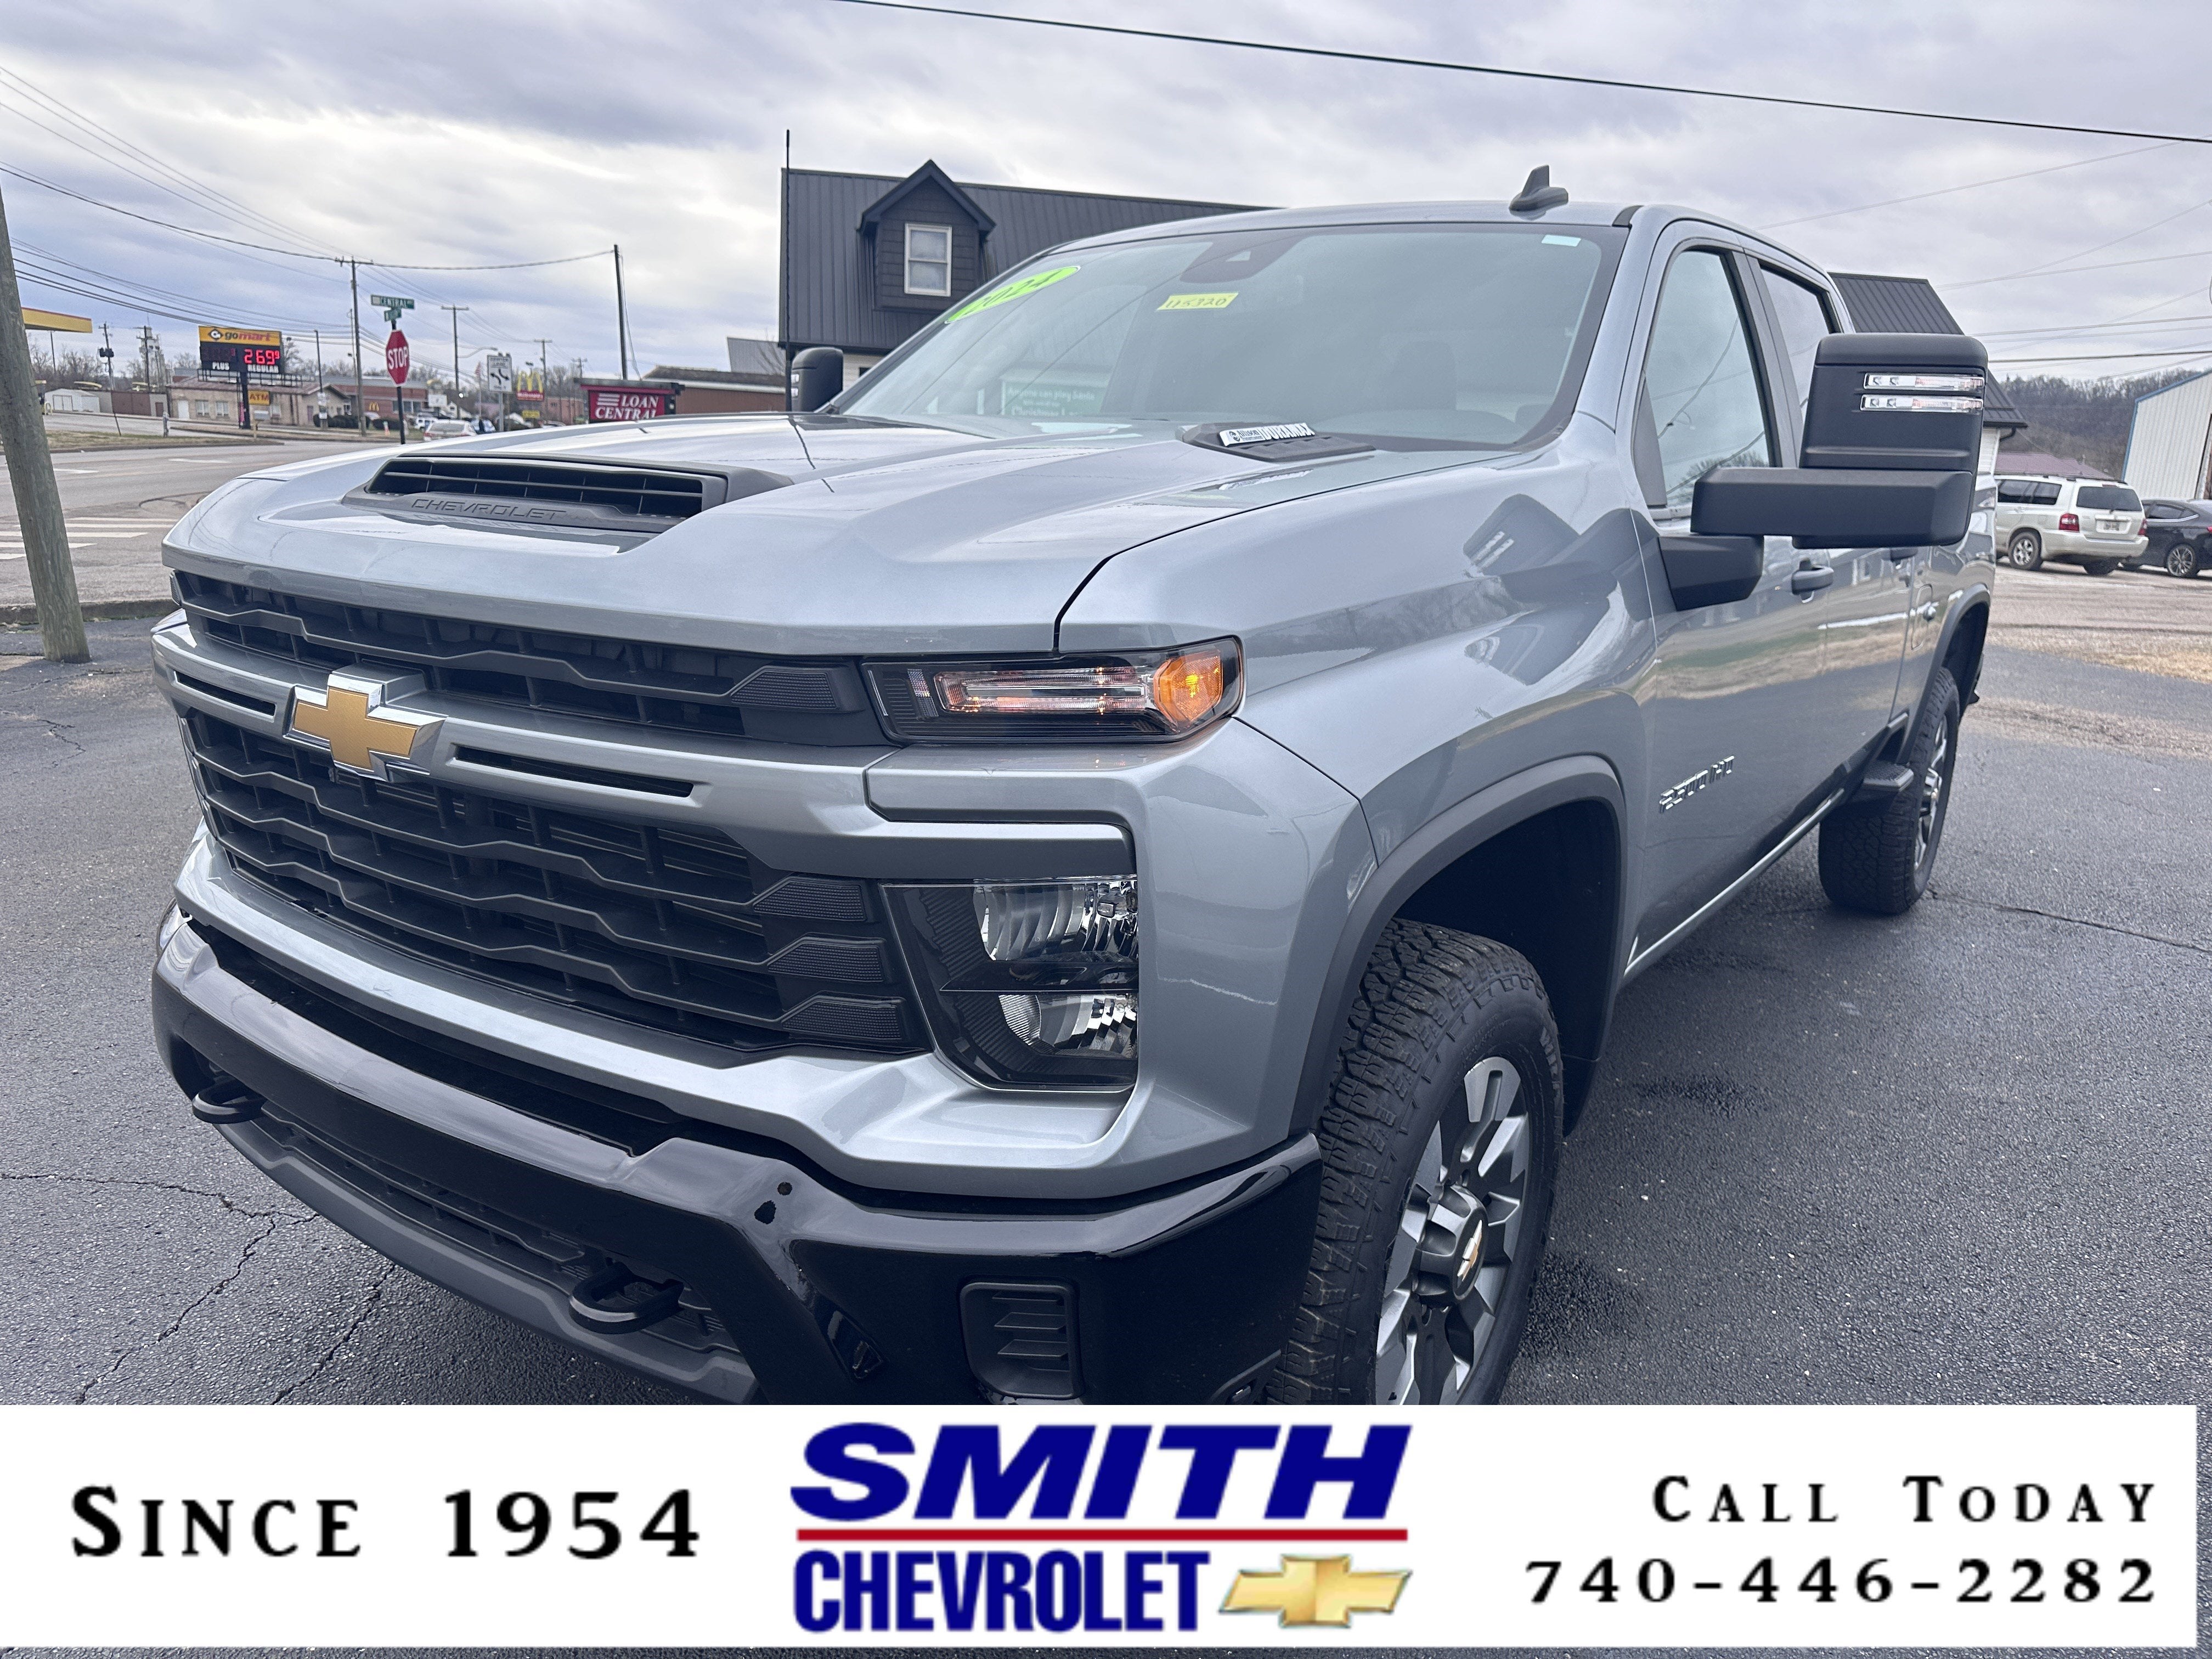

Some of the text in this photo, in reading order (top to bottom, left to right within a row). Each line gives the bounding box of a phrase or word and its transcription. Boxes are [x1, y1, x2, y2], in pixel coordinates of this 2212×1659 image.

[381, 297, 407, 309] CENTRAL
[388, 346, 409, 370] STOP
[212, 362, 230, 370] PLUS
[247, 364, 279, 373] REGULAR
[621, 394, 658, 409] LOAN
[595, 405, 657, 420] CENTRAL
[1261, 422, 1316, 441] DURAMAX
[411, 498, 567, 520] CHEVROLET
